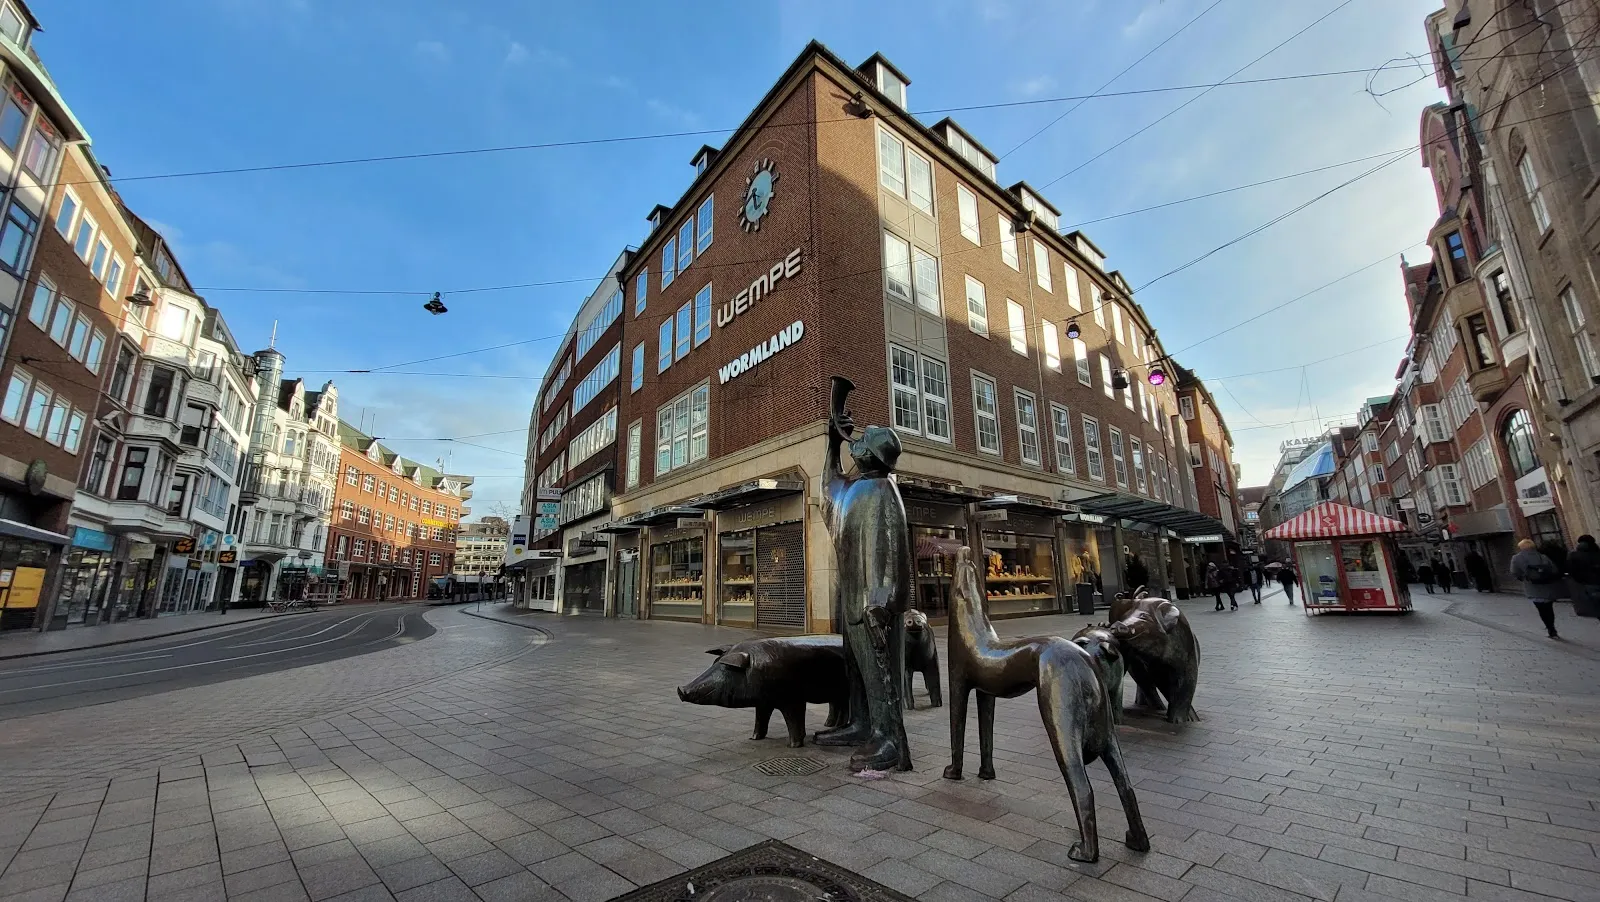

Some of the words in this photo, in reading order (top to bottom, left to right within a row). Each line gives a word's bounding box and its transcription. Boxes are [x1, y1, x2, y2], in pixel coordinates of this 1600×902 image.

[717, 247, 802, 328] WEMPE
[718, 320, 804, 386] WORMLAND
[739, 506, 776, 524] WEMPE
[905, 505, 937, 519] EMPE
